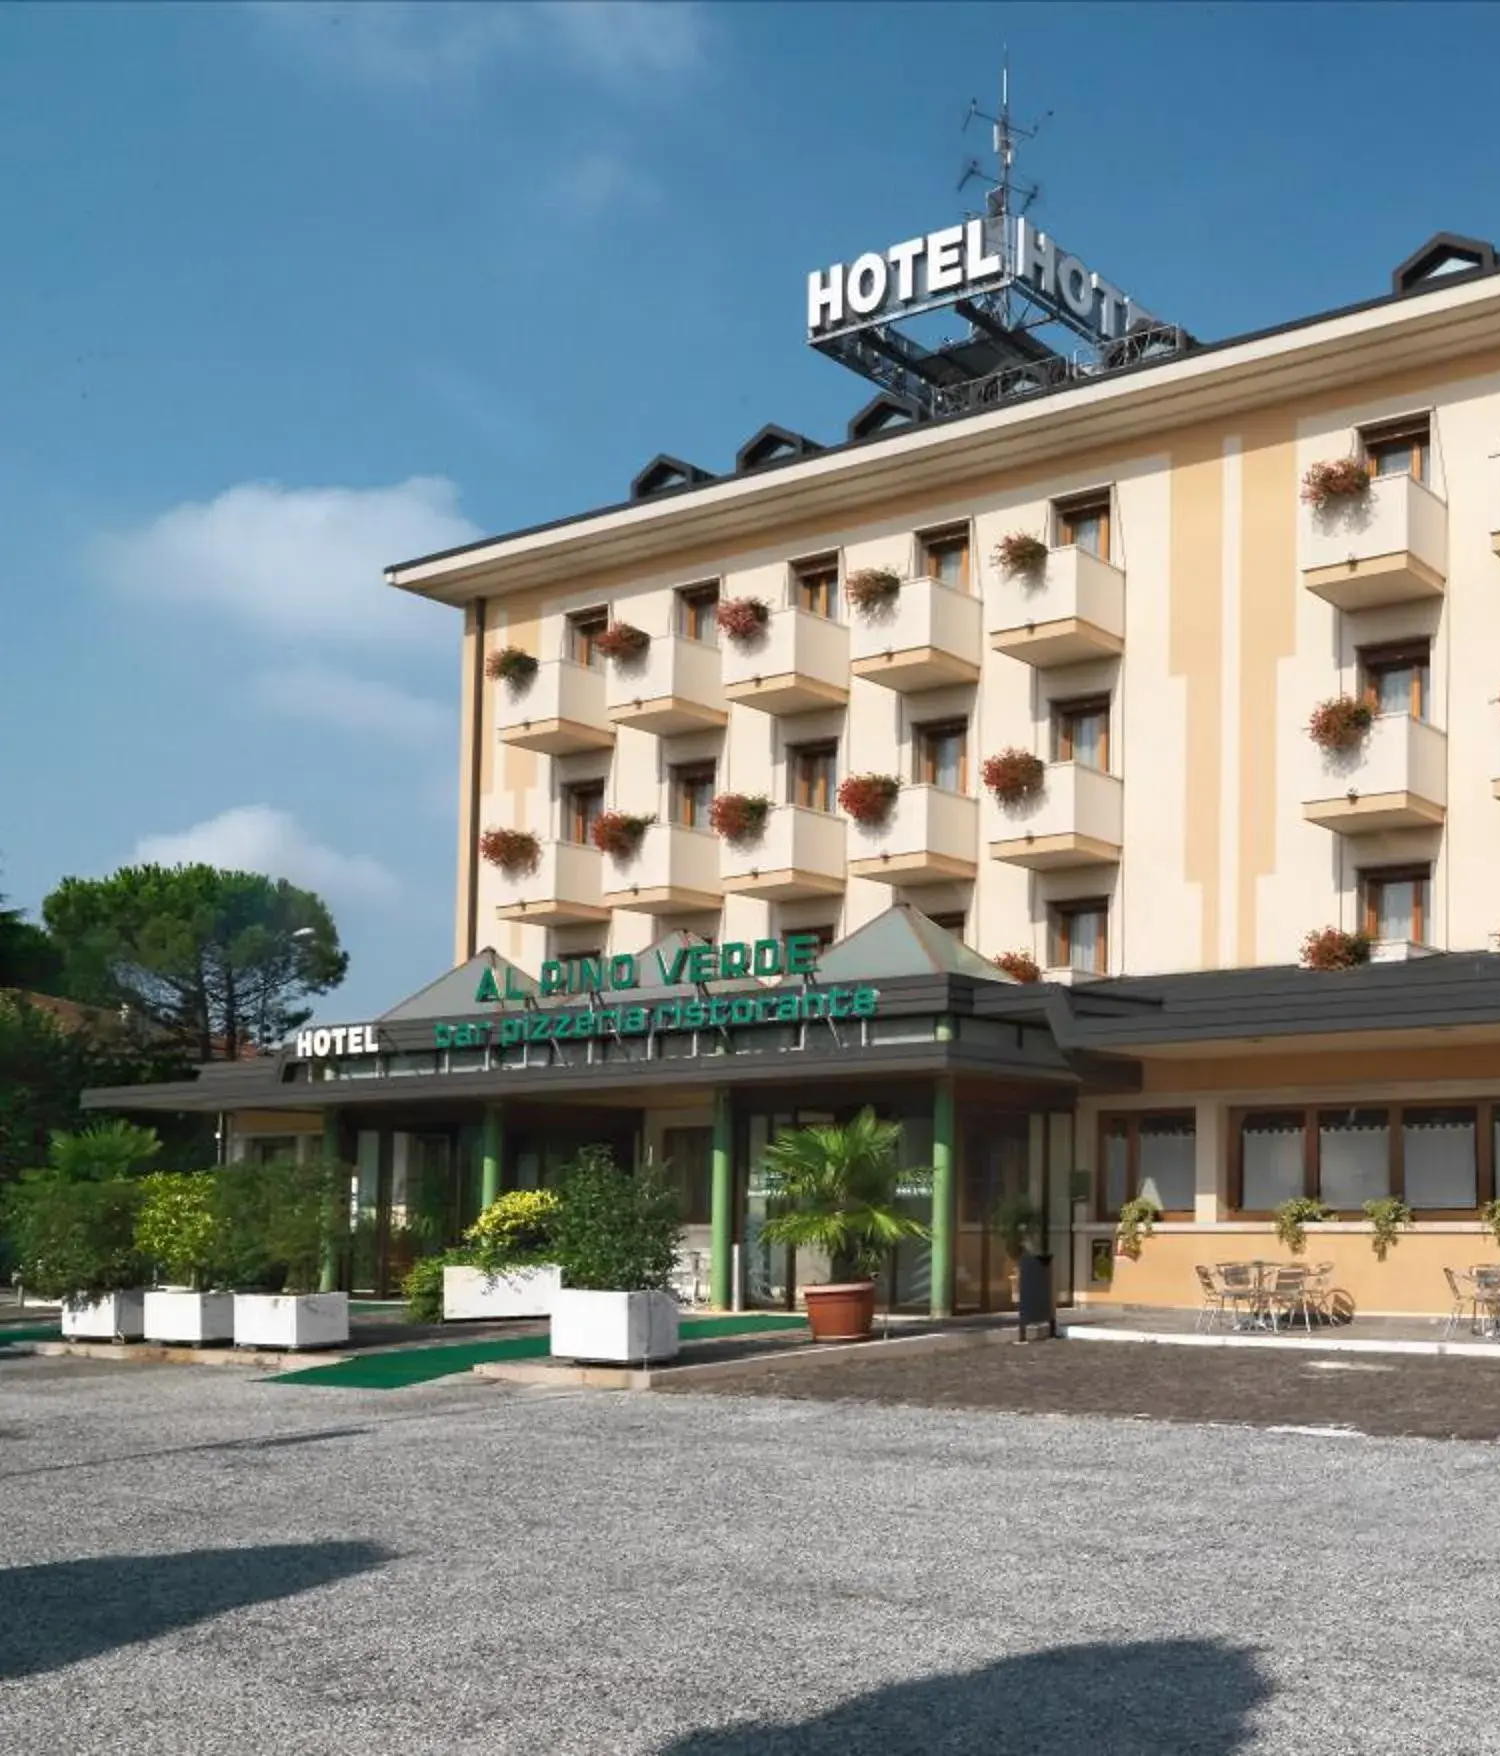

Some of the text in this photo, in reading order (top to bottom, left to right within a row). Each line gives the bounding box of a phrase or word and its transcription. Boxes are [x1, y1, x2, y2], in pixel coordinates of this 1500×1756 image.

[807, 218, 1002, 329] HOTEL
[1016, 216, 1158, 340] HOT
[475, 933, 822, 1002] AL PINO VERDE
[297, 1025, 380, 1057] HOTEL
[433, 986, 880, 1048] bar pizzeria ristorante
